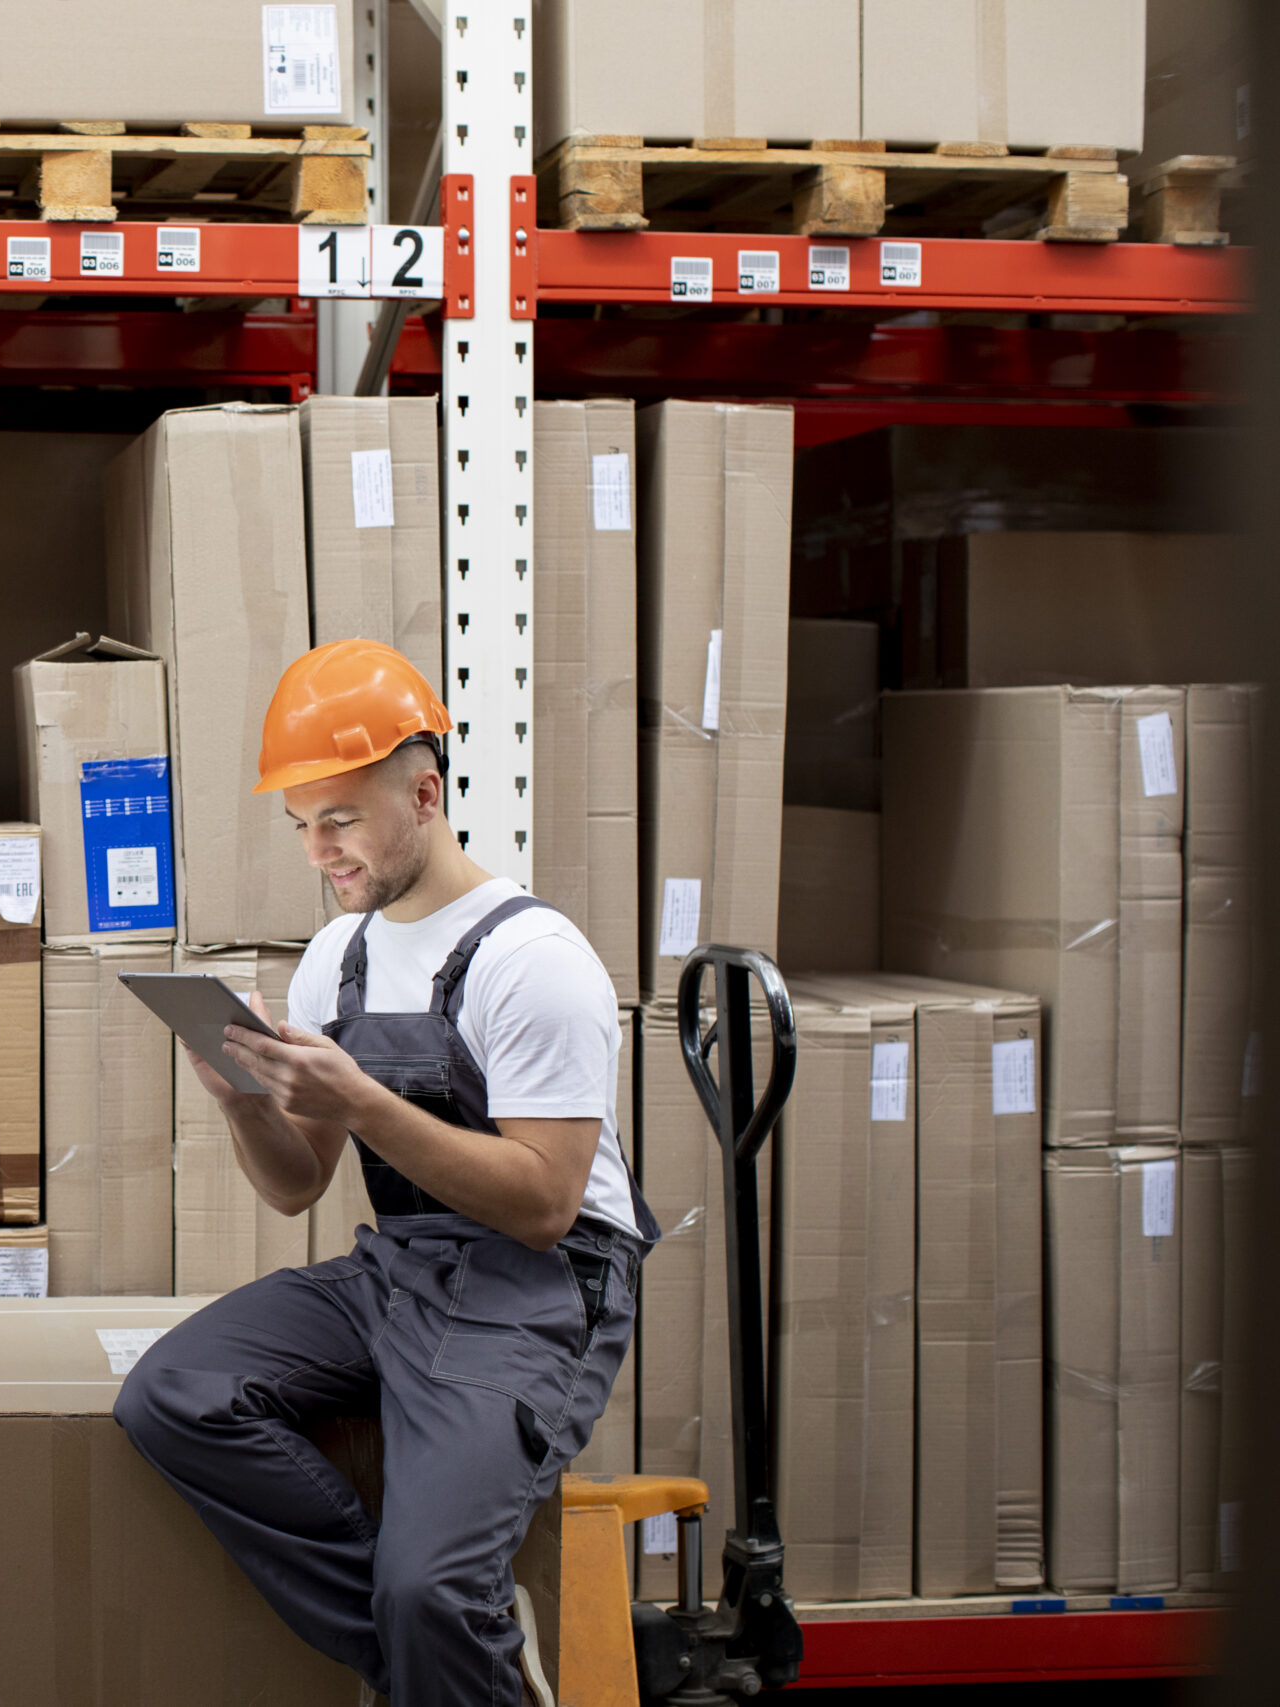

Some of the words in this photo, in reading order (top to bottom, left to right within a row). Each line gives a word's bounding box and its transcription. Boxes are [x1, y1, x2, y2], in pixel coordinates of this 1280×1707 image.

[176, 257, 196, 266] 006
[318, 231, 337, 283] 1
[391, 229, 424, 288] 2
[99, 262, 119, 270] 006
[26, 267, 47, 275] 006
[827, 276, 846, 284] 007
[899, 272, 918, 280] 007
[757, 280, 776, 289] 007
[689, 287, 709, 295] 007
[16, 882, 34, 897] EAC
